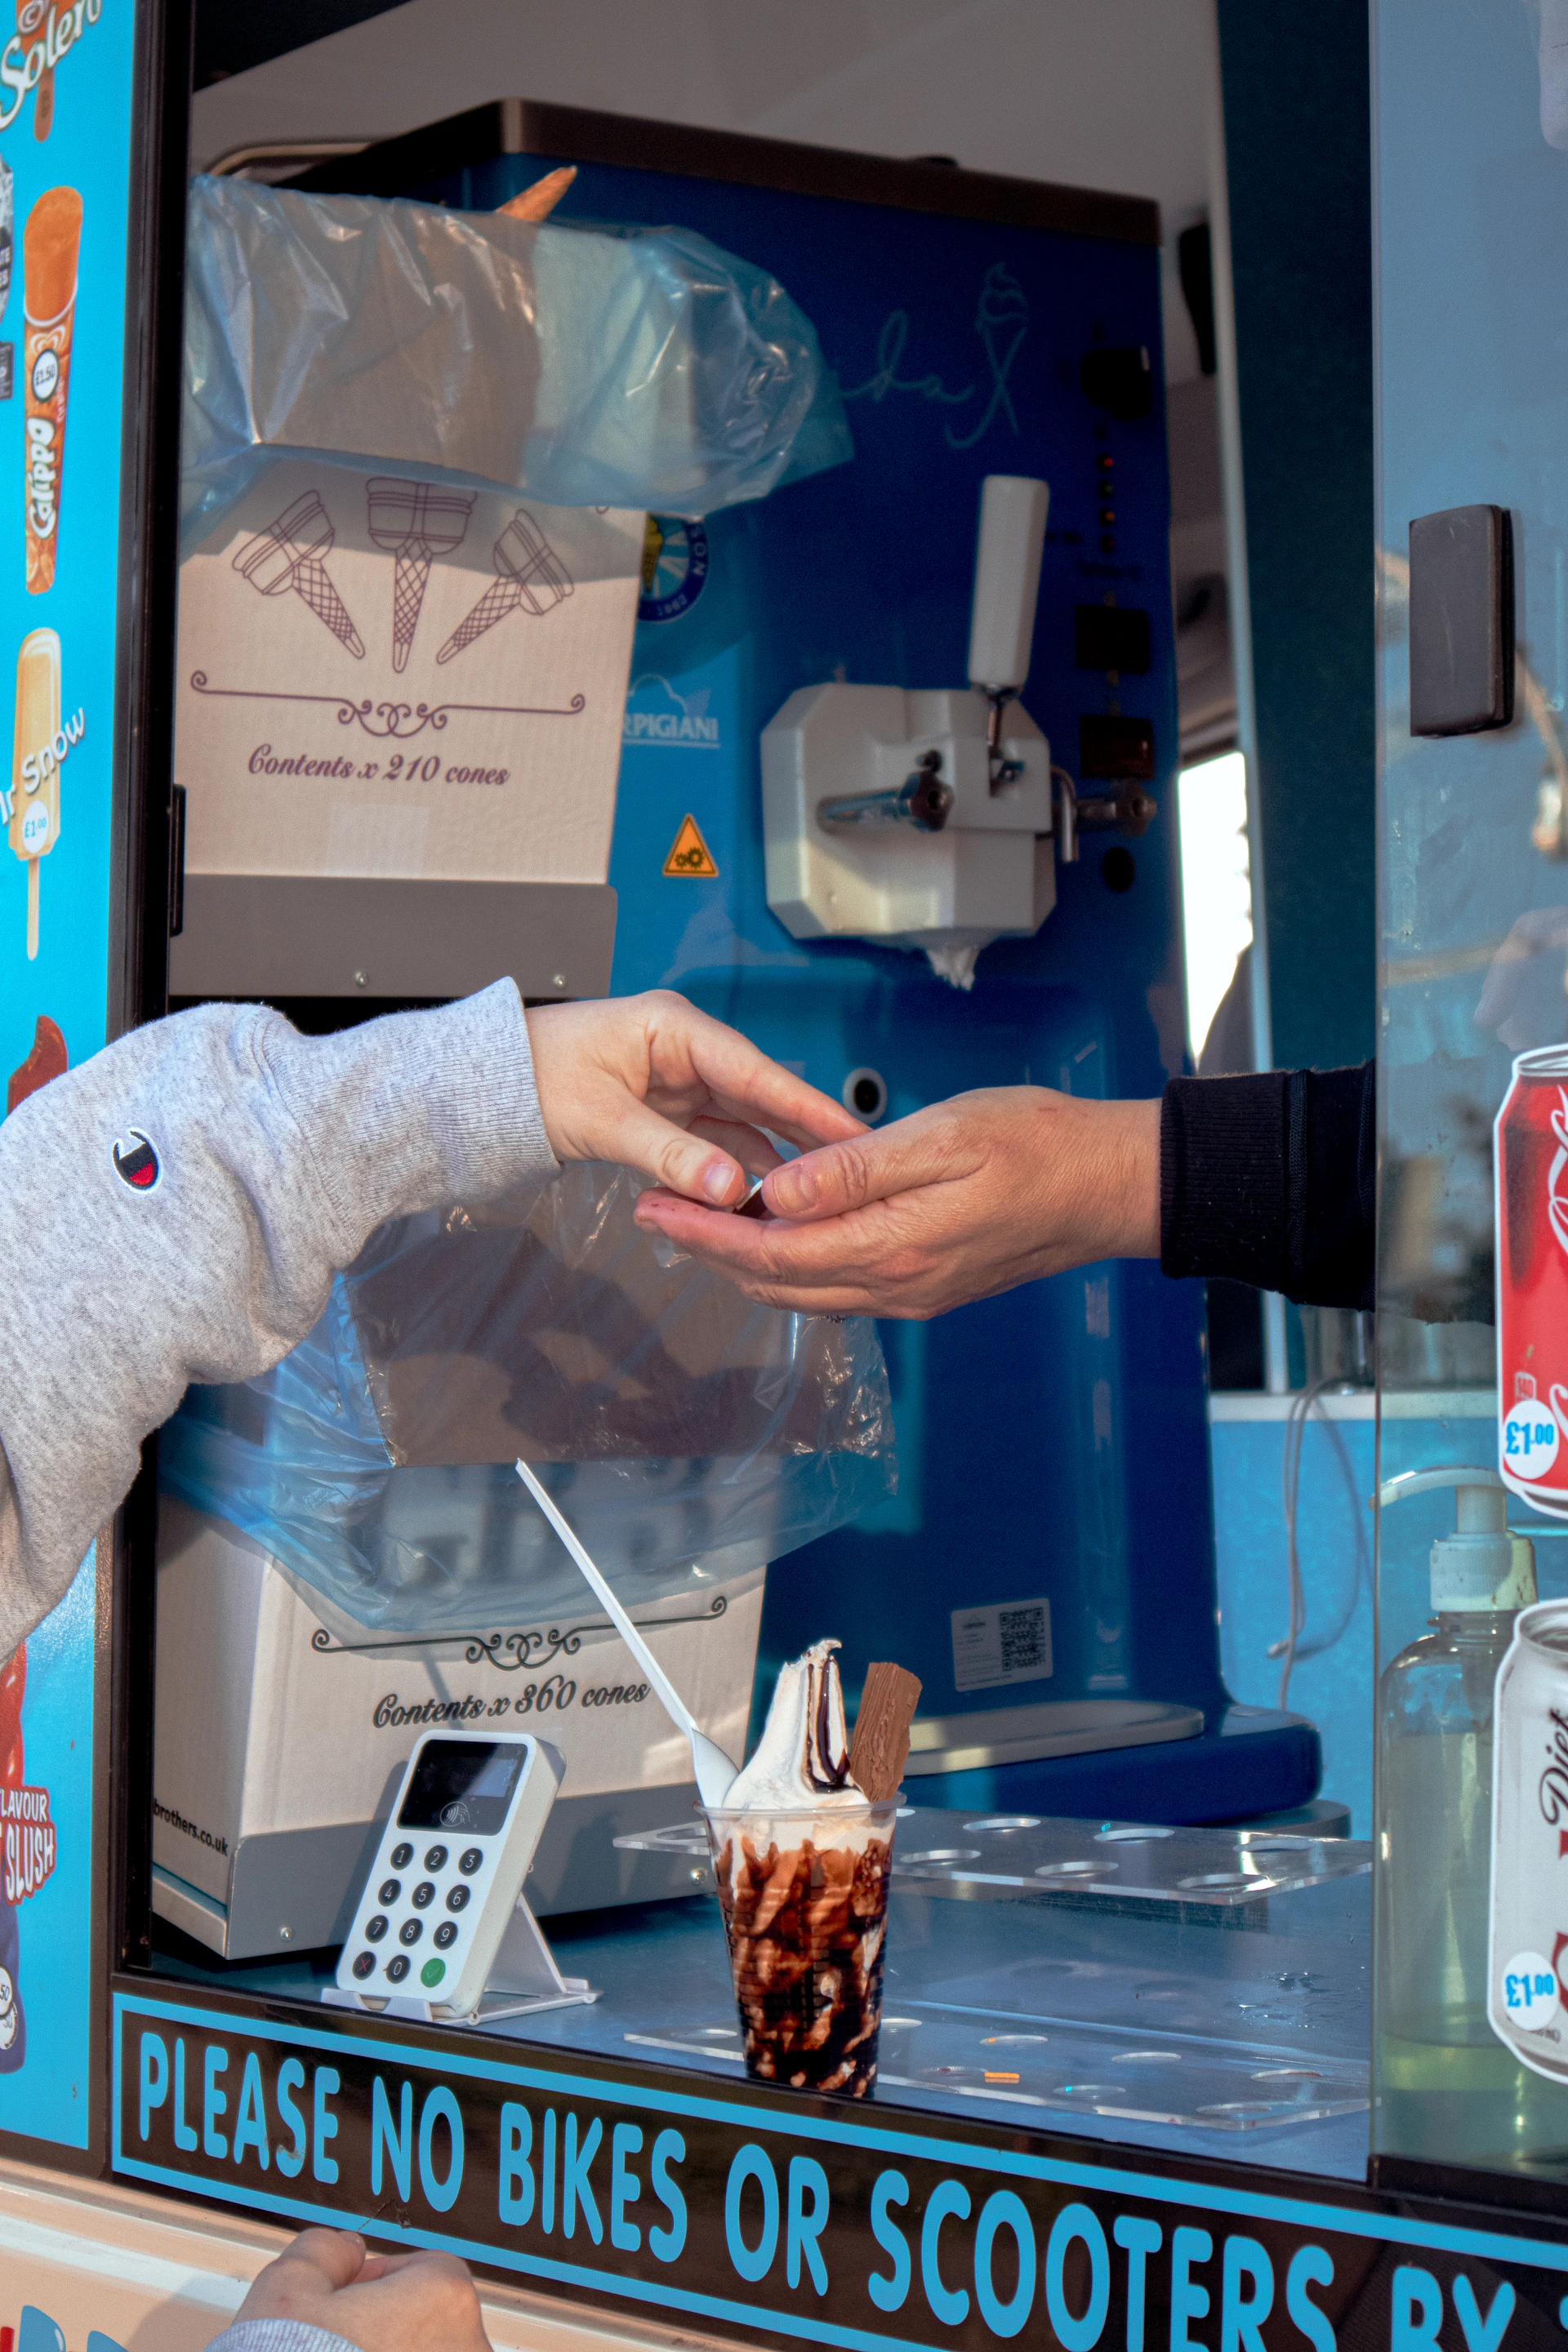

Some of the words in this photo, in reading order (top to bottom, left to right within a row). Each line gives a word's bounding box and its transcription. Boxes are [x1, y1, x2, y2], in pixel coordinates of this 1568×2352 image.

[27, 417, 56, 538] Calippo
[21, 707, 85, 795] Snow
[248, 743, 354, 778] Contents
[358, 762, 379, 779] x
[382, 754, 441, 782] 210
[445, 766, 510, 785] cones
[1506, 1421, 1554, 1455] £1.00
[373, 1694, 486, 1728] Contents
[488, 1696, 510, 1717] x
[514, 1675, 577, 1713] 360
[581, 1682, 651, 1708] cones
[0, 1787, 47, 1823] LAVOUR
[5, 1823, 54, 1901] SLUSH
[397, 1851, 405, 1863] 1
[430, 1852, 439, 1865] 2
[466, 1855, 474, 1868] 3
[385, 1886, 392, 1899] 4
[419, 1889, 427, 1902] 5
[453, 1892, 461, 1904] 6
[373, 1922, 381, 1935] 7
[406, 1926, 415, 1939] 8
[441, 1928, 449, 1941] 9
[394, 1962, 402, 1976] 0
[1505, 1973, 1555, 2008] £1.00
[139, 2033, 340, 2185] PLEASE
[371, 2076, 464, 2212] NO
[498, 2101, 688, 2263] BIKES
[724, 2144, 829, 2296] OR
[867, 2169, 1337, 2352] SCOOTERS
